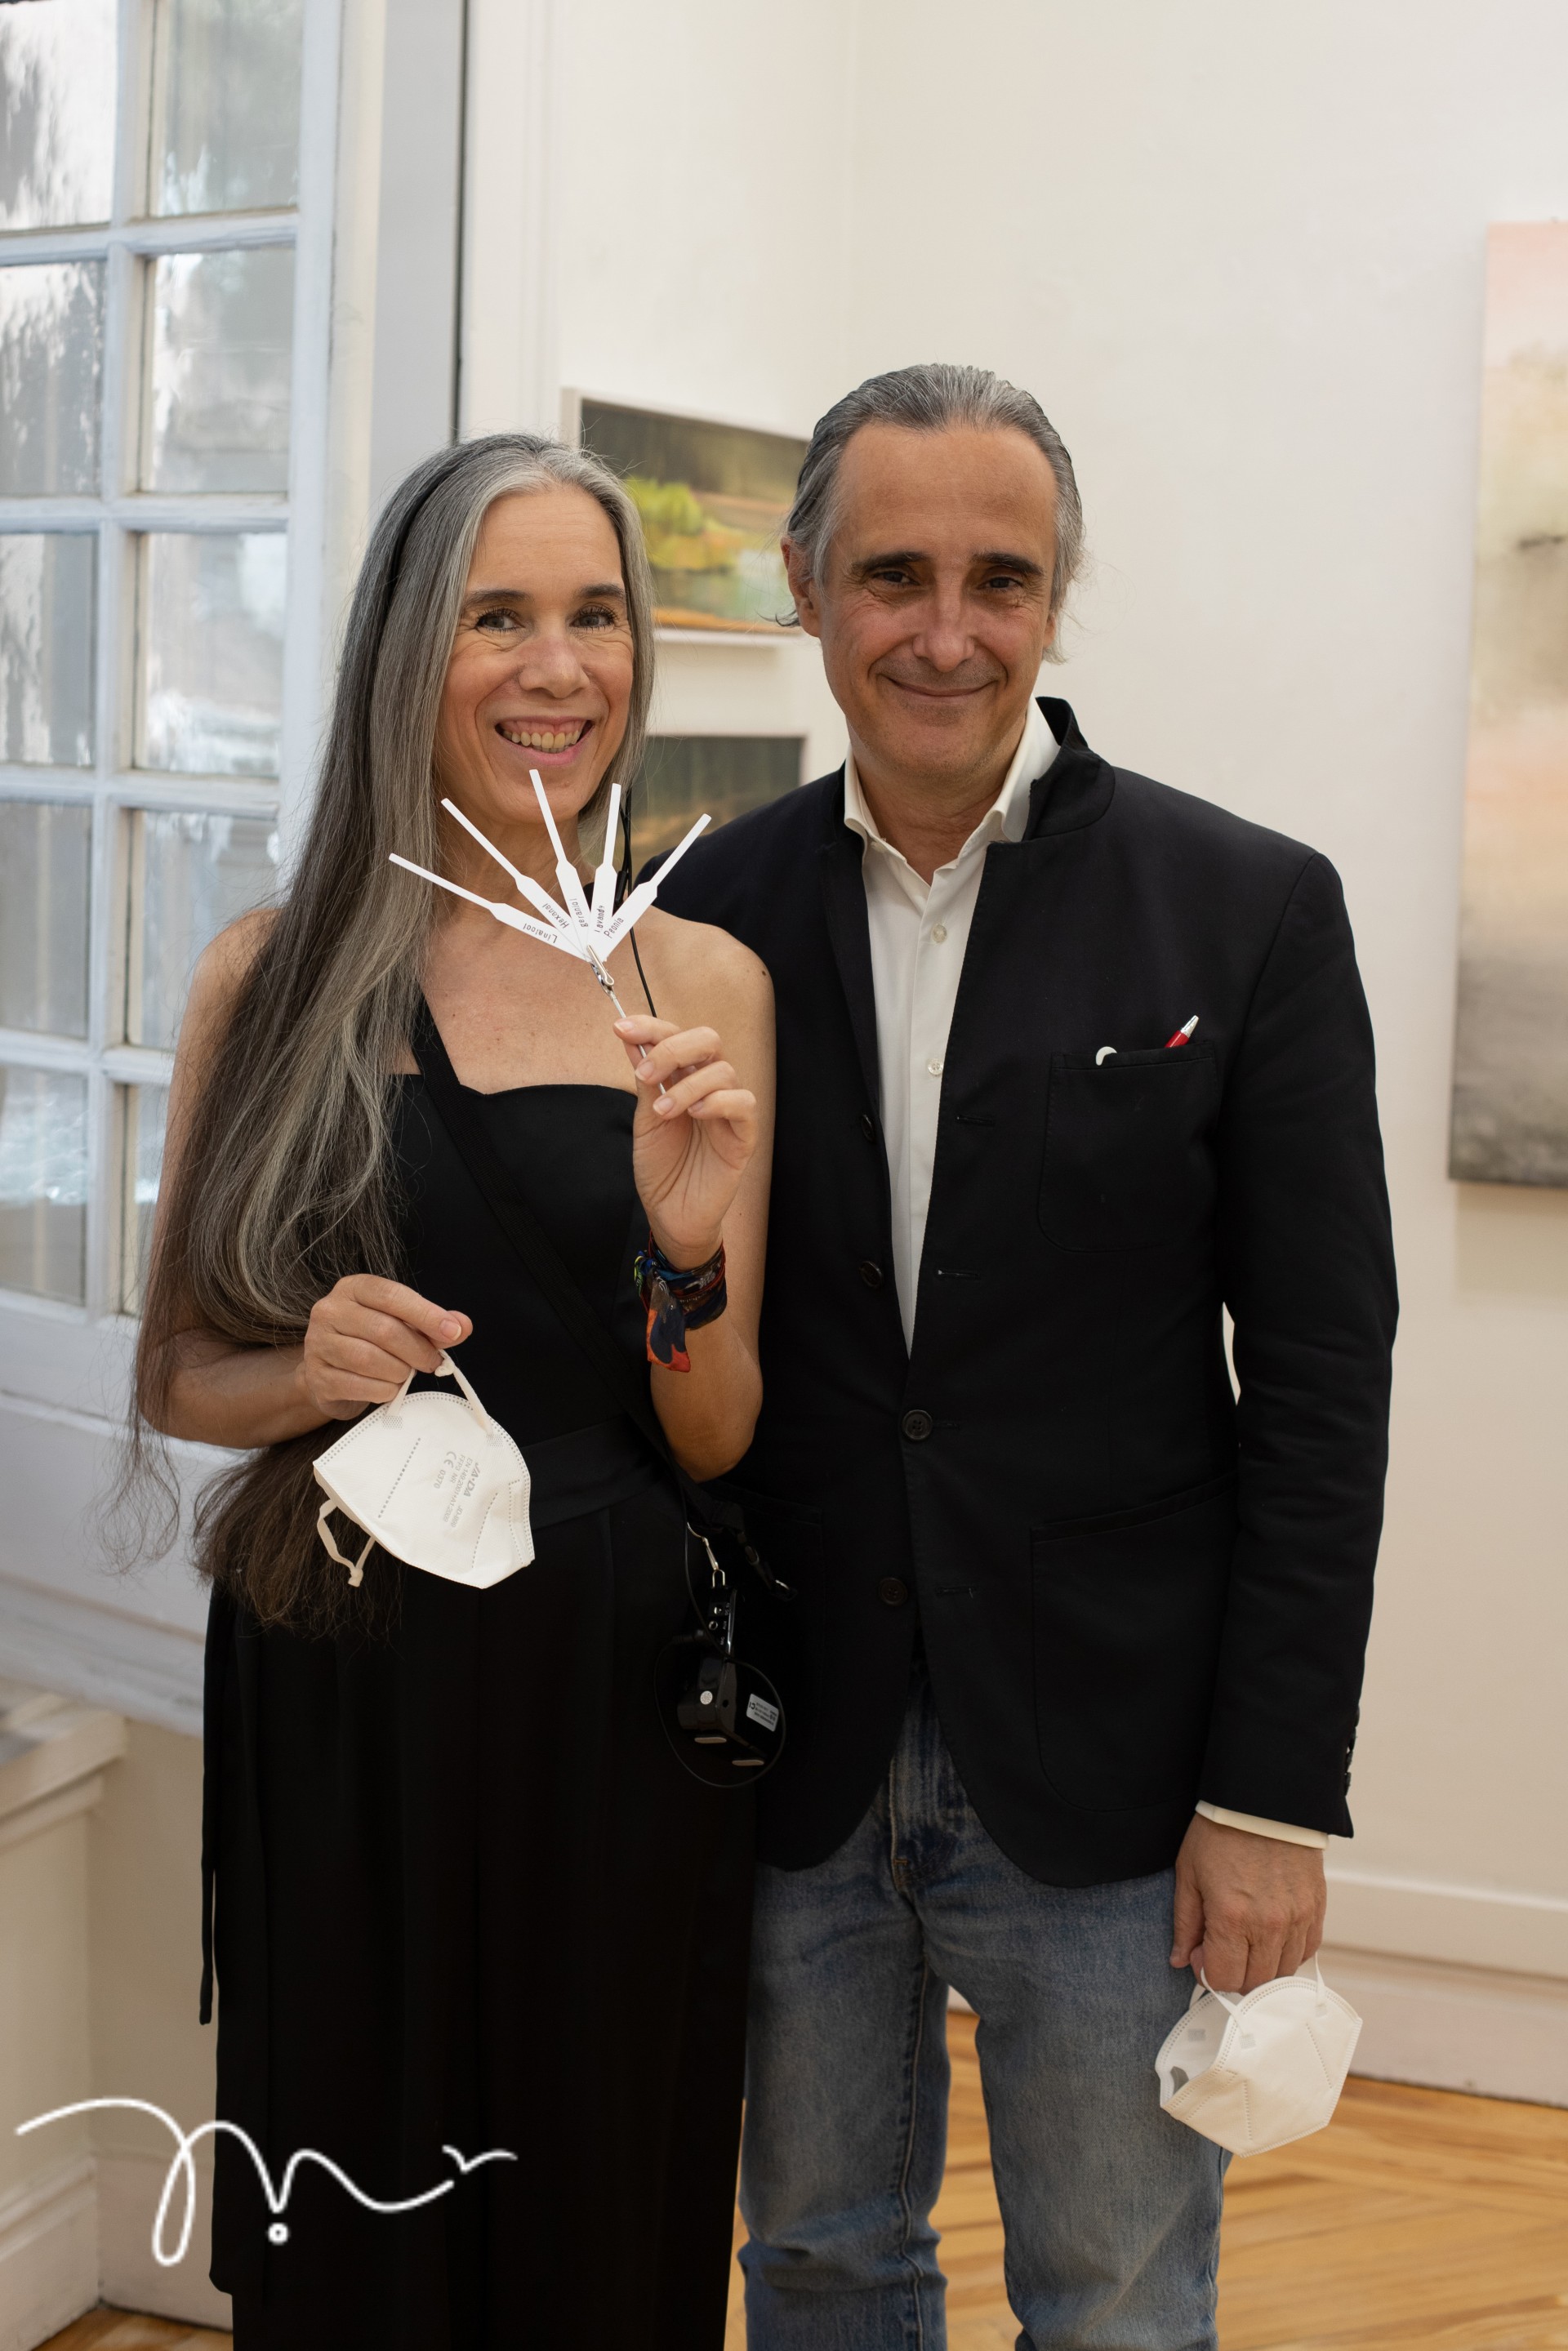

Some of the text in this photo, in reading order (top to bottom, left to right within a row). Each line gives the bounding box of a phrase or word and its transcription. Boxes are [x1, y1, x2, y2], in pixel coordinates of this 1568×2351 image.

[541, 903, 570, 928] Hexanal
[523, 923, 558, 943] Linalool
[604, 917, 625, 939] Peonia
[450, 1454, 466, 1484] FFP3 NR
[465, 1458, 473, 1467] EN
[434, 1469, 446, 1489] 0370
